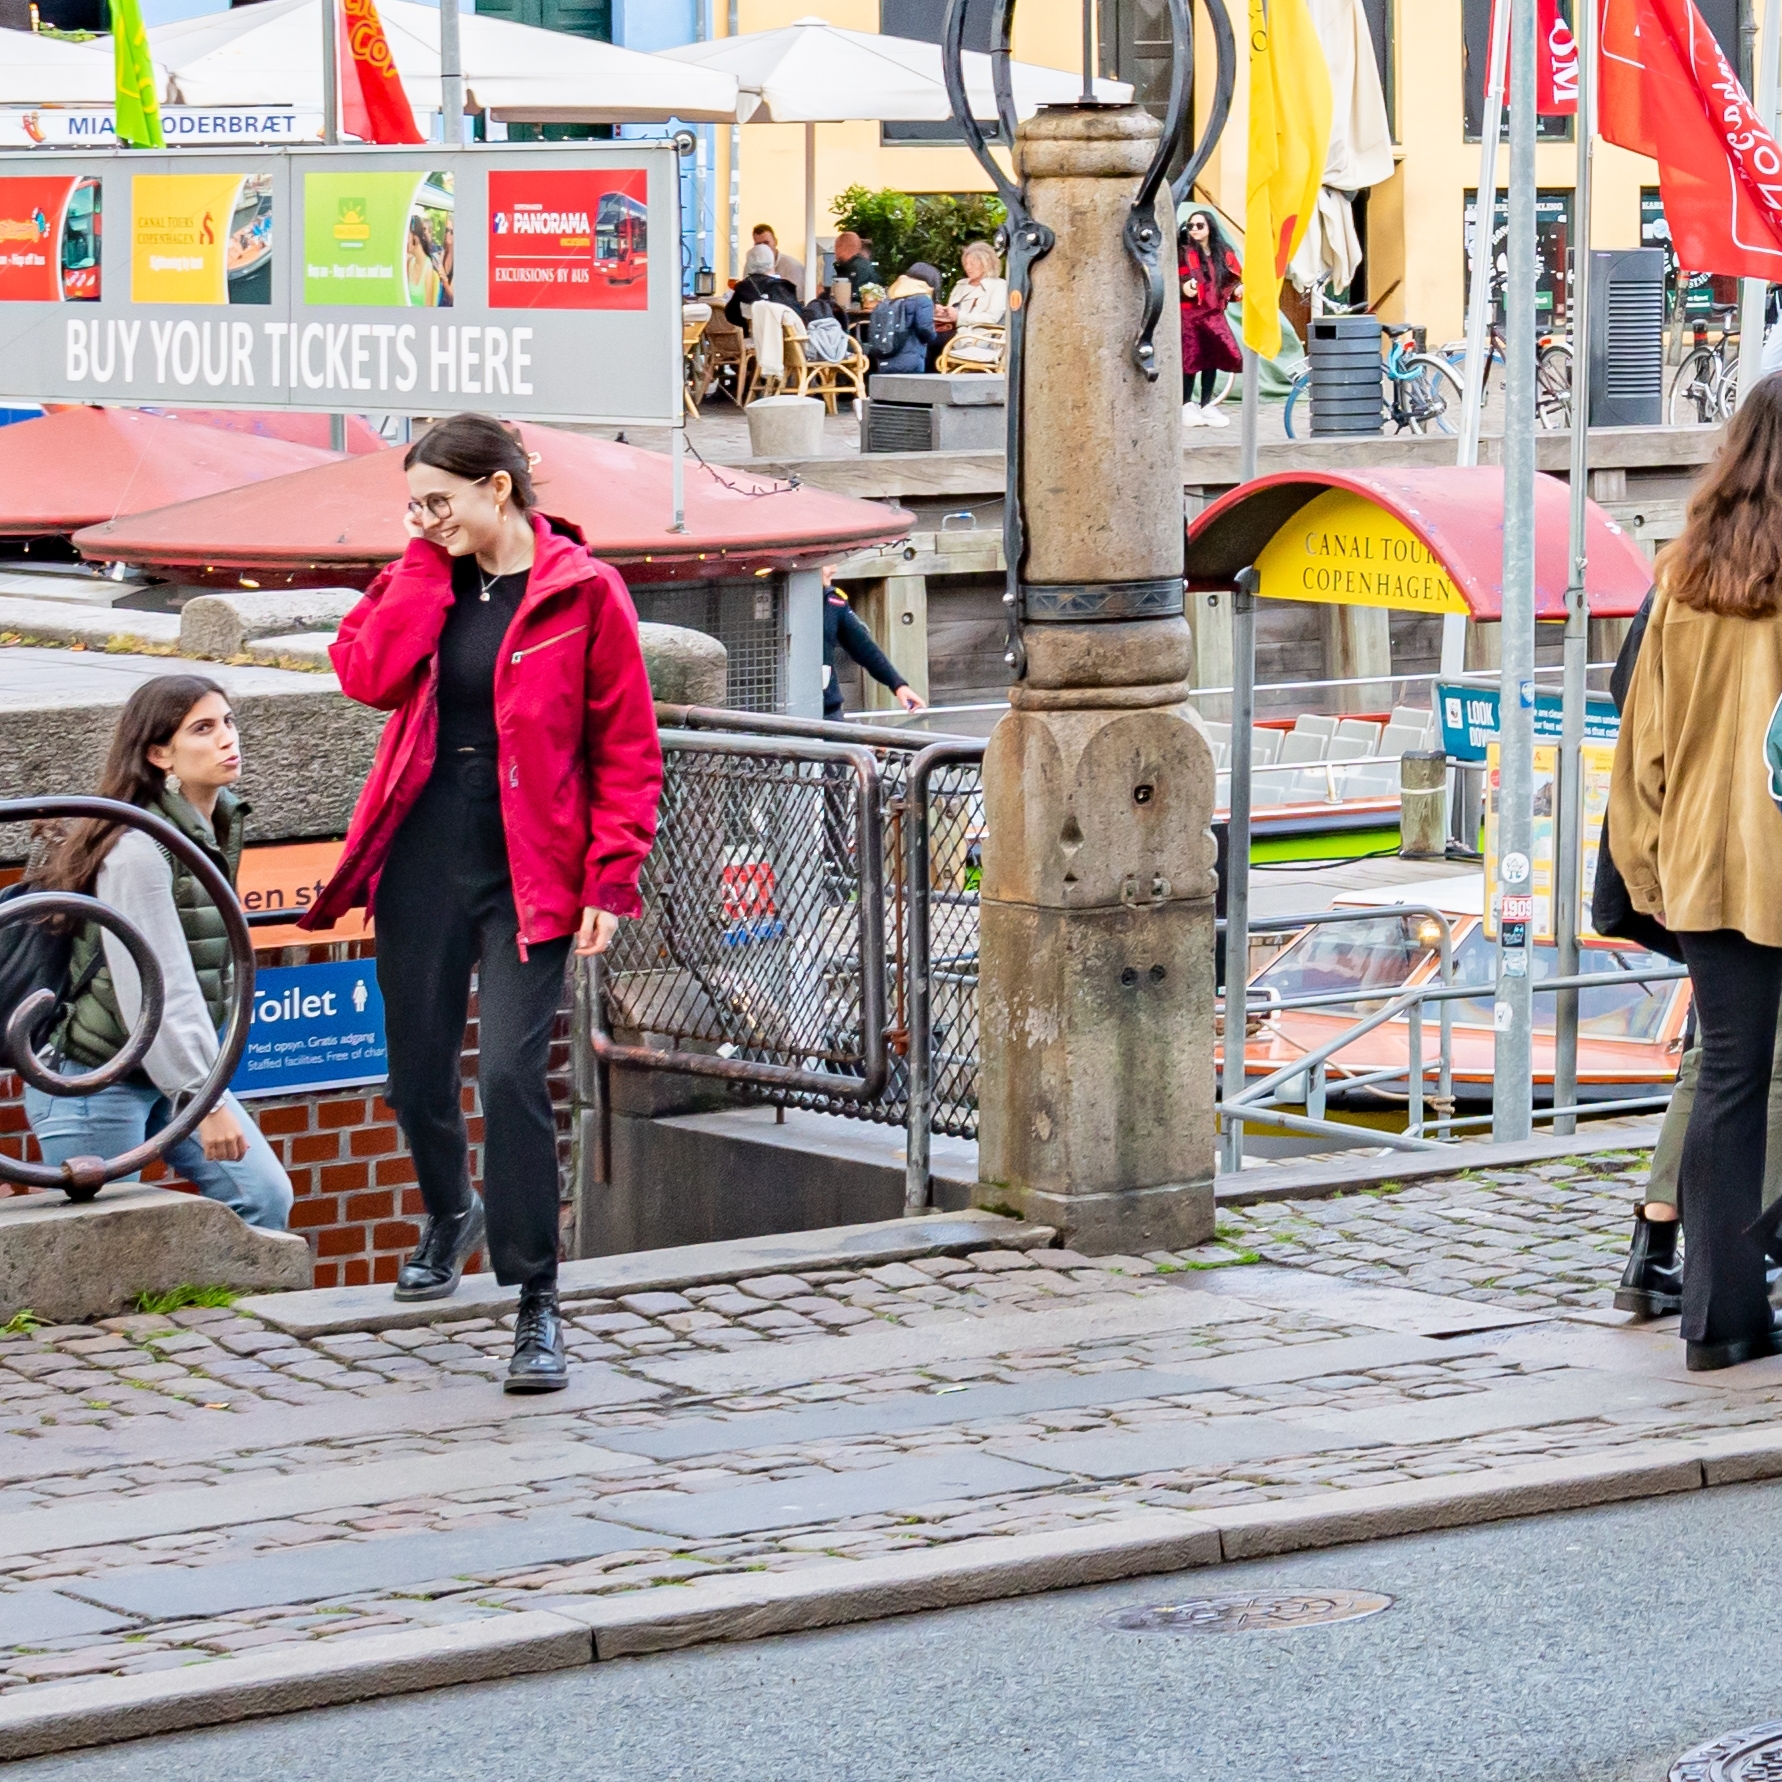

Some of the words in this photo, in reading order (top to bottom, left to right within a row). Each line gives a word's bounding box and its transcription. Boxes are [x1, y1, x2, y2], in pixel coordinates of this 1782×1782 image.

[69, 116, 115, 135] MIA
[161, 115, 296, 135] ODERBRÆT
[138, 217, 165, 228] CANAL
[168, 217, 194, 228] TOURS
[513, 212, 590, 234] PANORAMA
[137, 233, 195, 244] COPENHAGEN
[495, 268, 555, 284] EXCURSIONS
[557, 268, 568, 284] BY
[571, 268, 590, 284] BUS
[66, 318, 142, 383] BUY
[149, 320, 254, 387] YOUR
[264, 321, 418, 392] TICKETS
[429, 324, 534, 396] HERE
[1305, 531, 1374, 560] CANAL
[1381, 538, 1438, 565] TOUR
[1303, 567, 1451, 602] COPENHAGEN
[1467, 700, 1495, 726] LOOK
[1503, 899, 1533, 917] 1909
[248, 1042, 271, 1055] Med
[308, 1035, 338, 1049] Gratis
[340, 1031, 375, 1047] adgang
[248, 1058, 282, 1072] Staffed
[326, 1050, 349, 1063] Free
[351, 1048, 362, 1060] of
[364, 1046, 388, 1060] char
